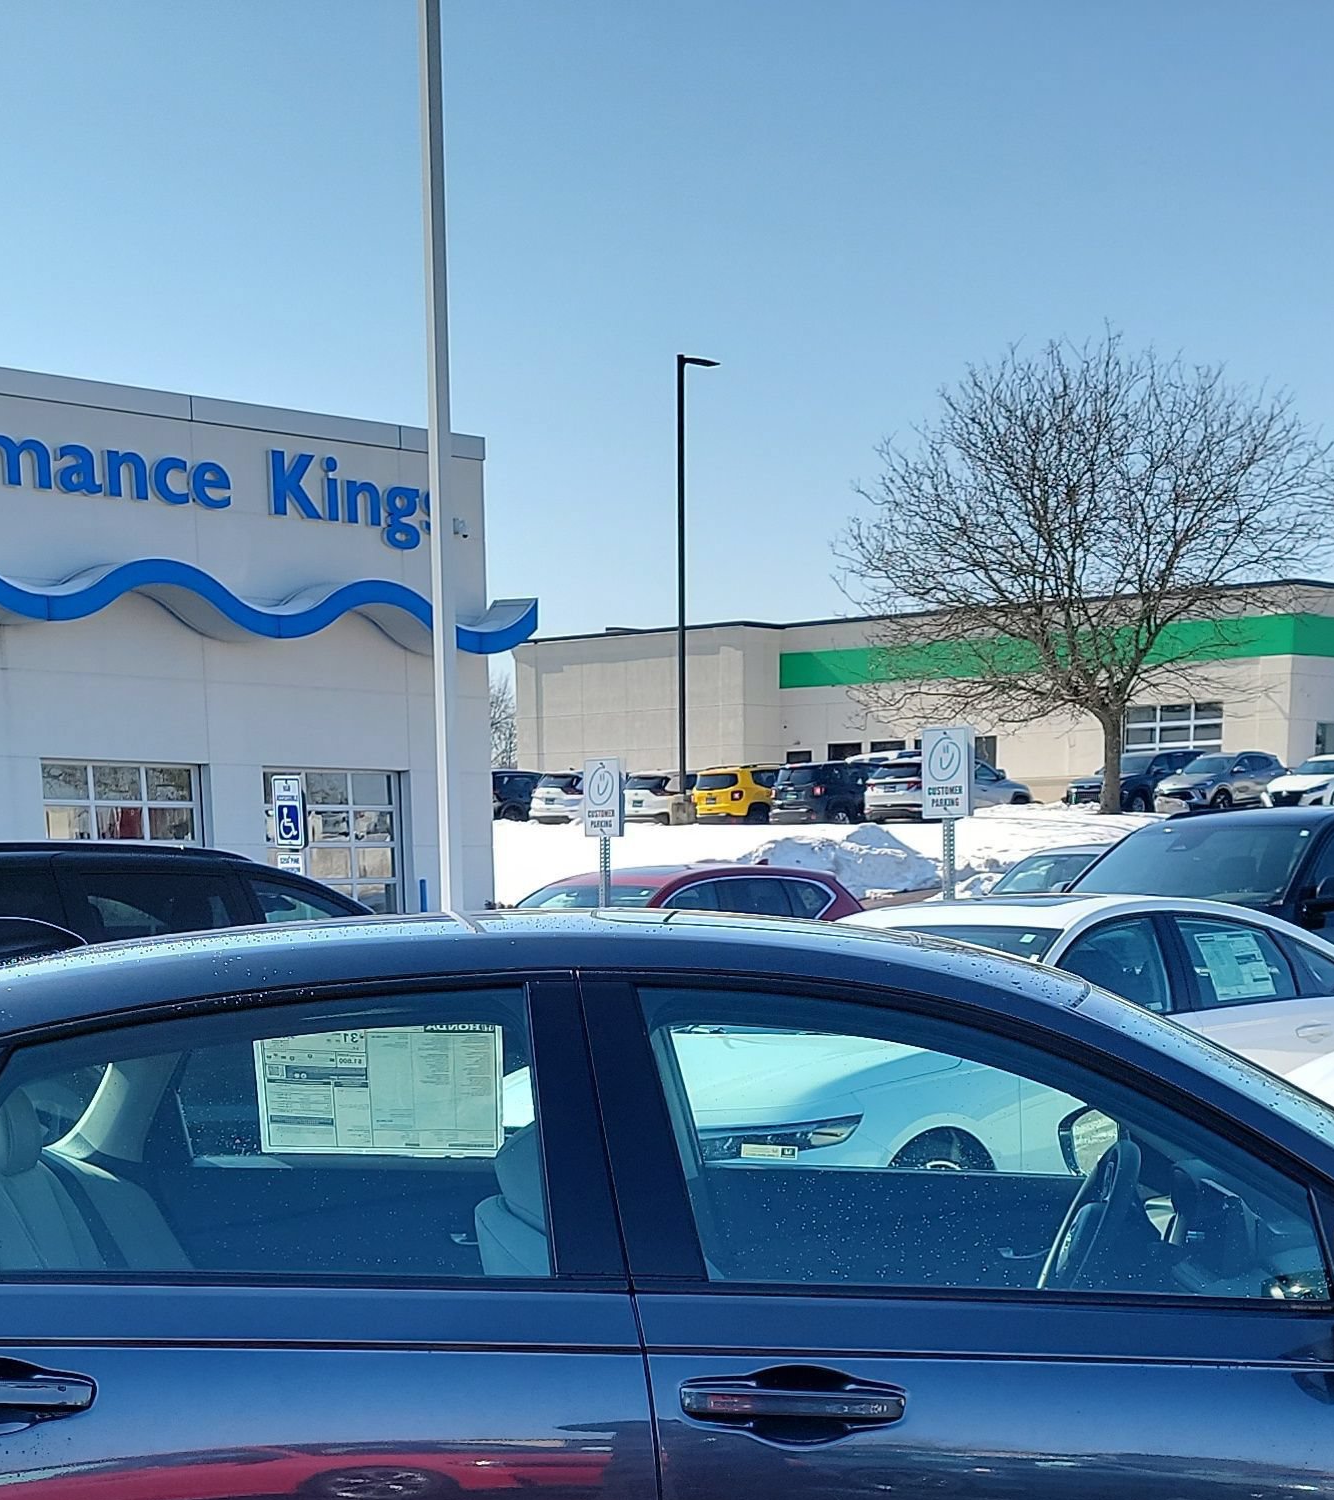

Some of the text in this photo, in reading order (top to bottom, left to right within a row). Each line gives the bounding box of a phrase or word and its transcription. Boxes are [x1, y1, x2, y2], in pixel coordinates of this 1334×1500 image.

[928, 785, 963, 796] CUSTOMER
[931, 797, 960, 808] PARKING
[588, 809, 615, 818] CUSTOMER
[591, 820, 612, 828] PARKING
